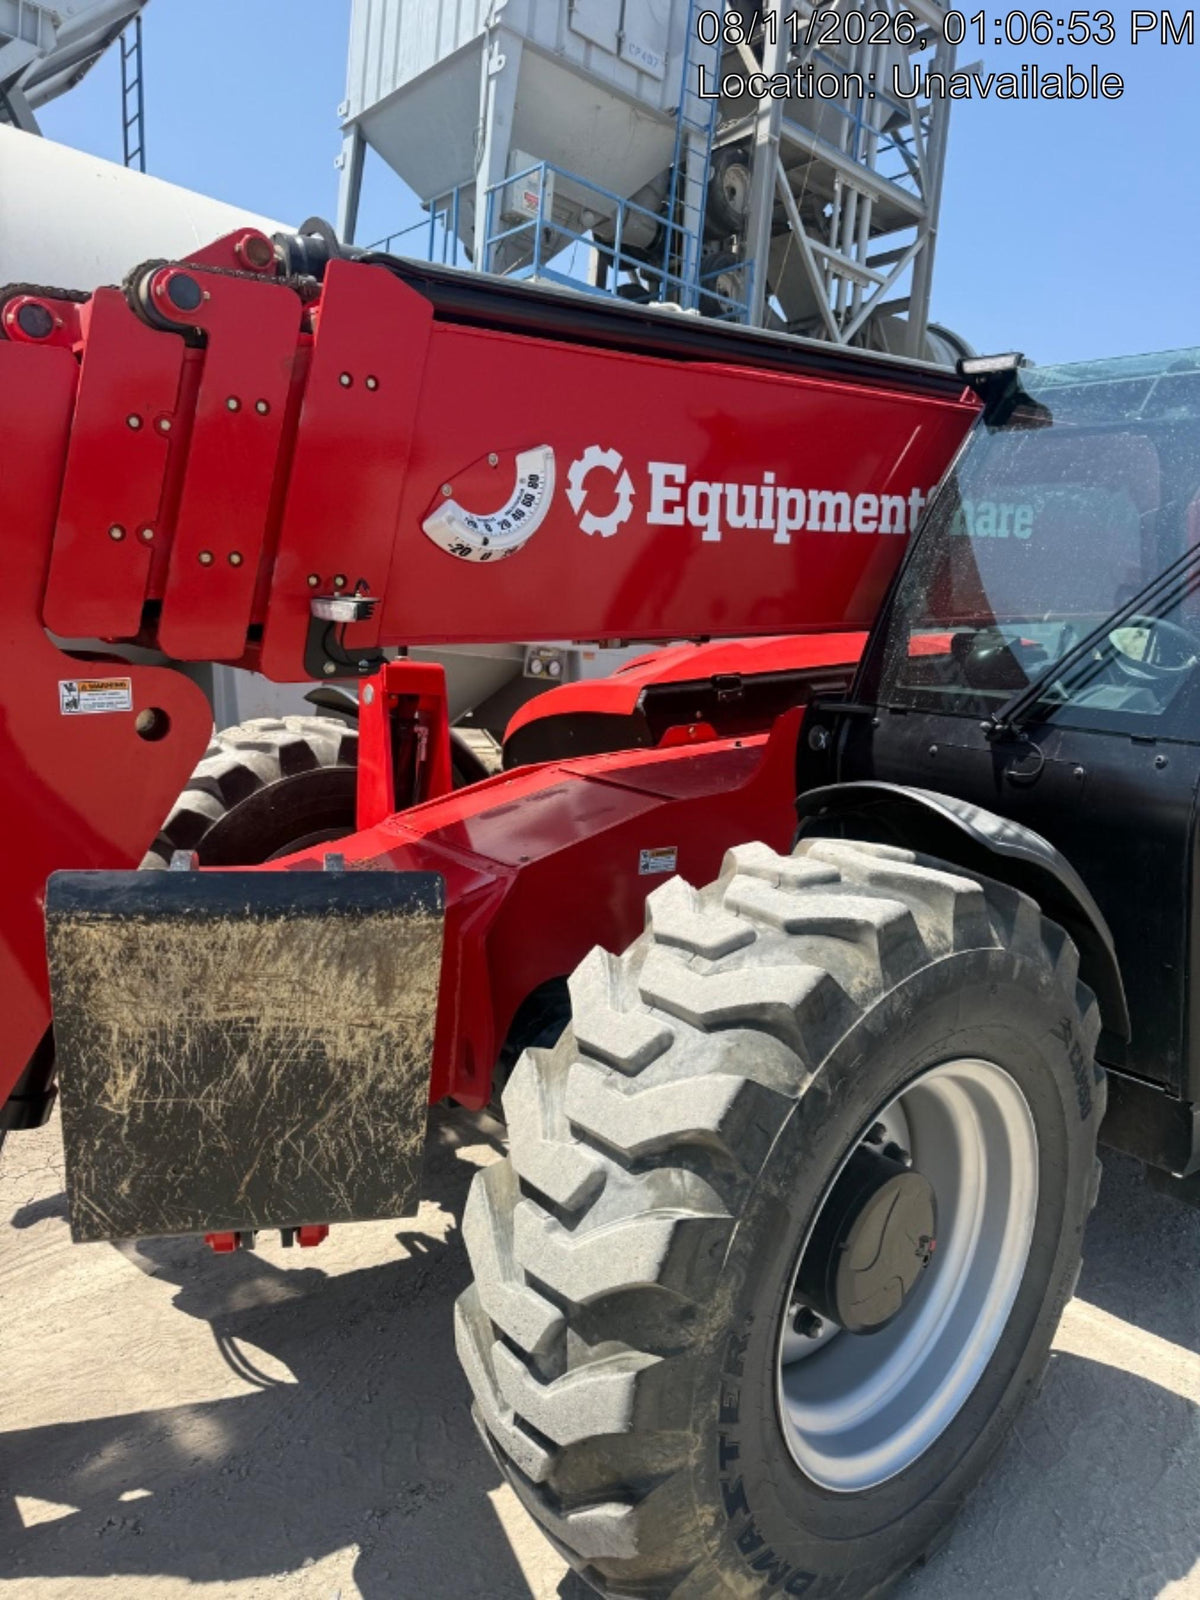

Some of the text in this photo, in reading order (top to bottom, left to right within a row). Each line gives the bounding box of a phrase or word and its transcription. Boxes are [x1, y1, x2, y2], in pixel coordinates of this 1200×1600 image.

[527, 474, 540, 489] 80
[521, 493, 535, 508] 60
[646, 460, 1034, 545] Equipmenthare
[511, 507, 526, 522] 40
[447, 543, 473, 557] -20
